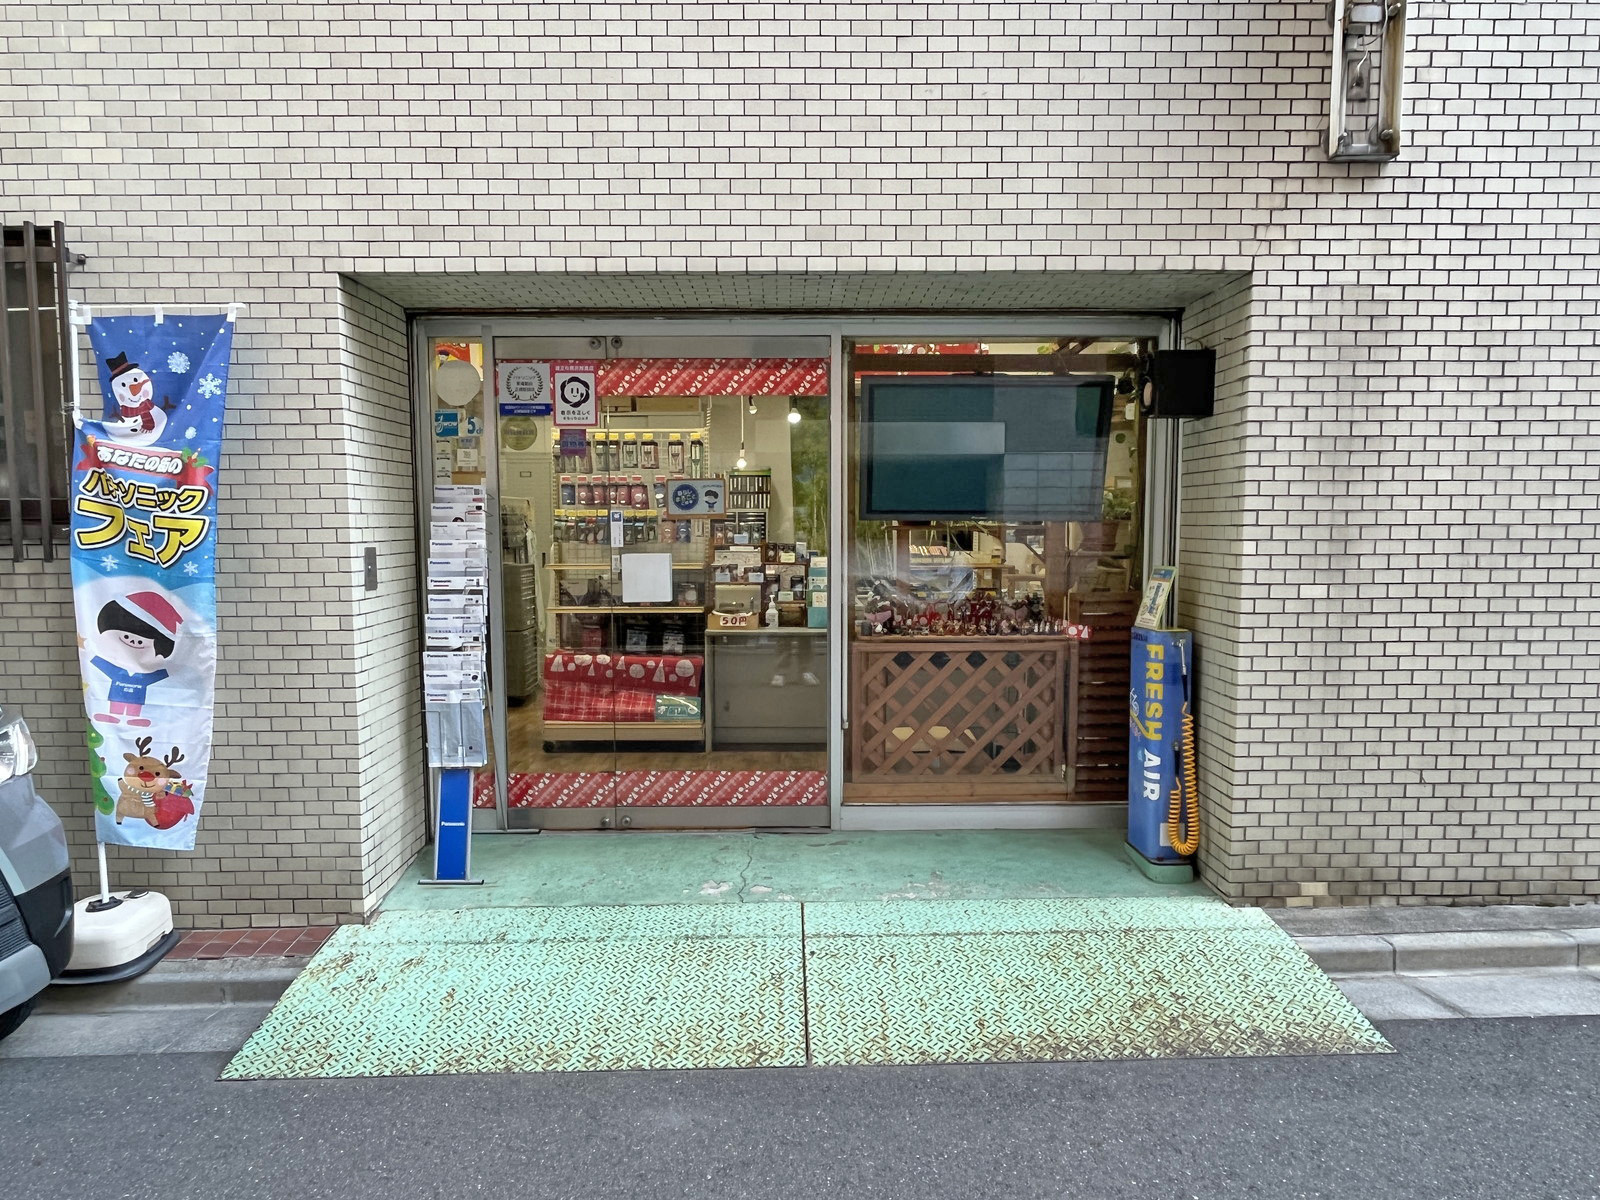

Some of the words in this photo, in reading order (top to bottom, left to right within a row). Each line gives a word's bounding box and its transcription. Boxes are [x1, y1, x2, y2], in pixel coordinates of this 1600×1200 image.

[83, 471, 206, 513] パナソニック
[76, 498, 207, 567] フェア
[722, 616, 748, 625] 50円
[1145, 643, 1164, 741] FRESH
[1143, 748, 1160, 801] AIR
